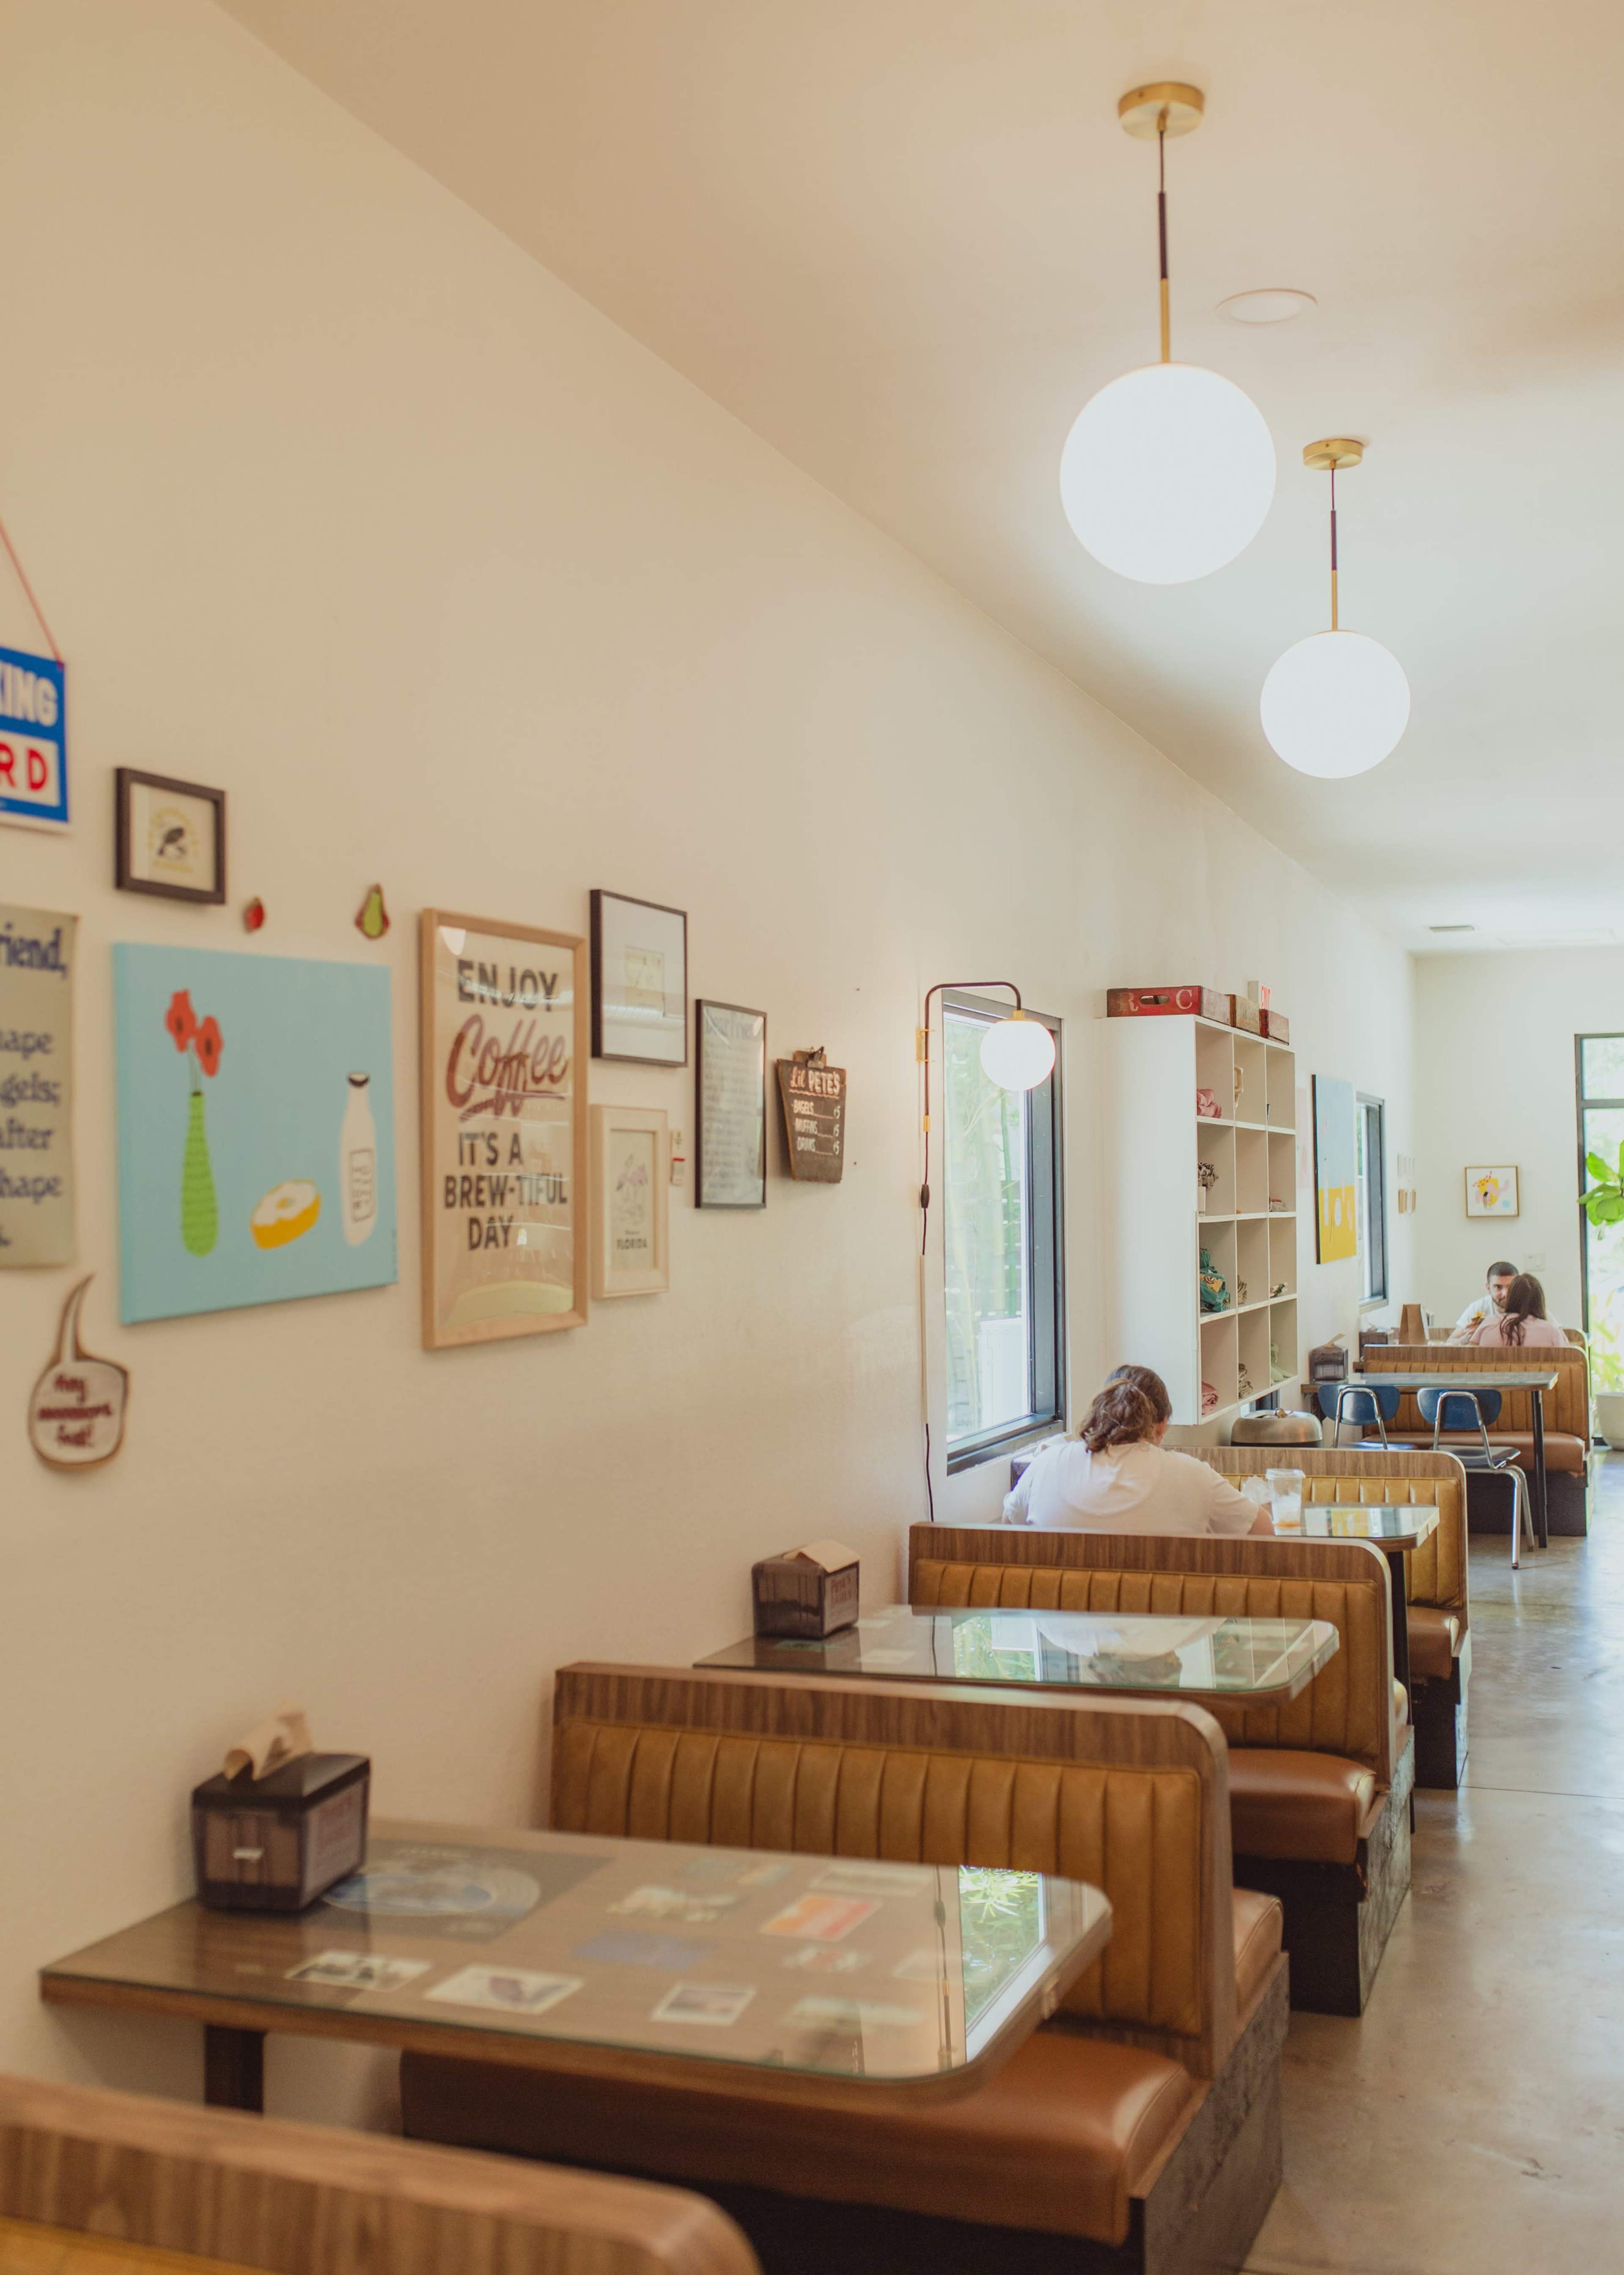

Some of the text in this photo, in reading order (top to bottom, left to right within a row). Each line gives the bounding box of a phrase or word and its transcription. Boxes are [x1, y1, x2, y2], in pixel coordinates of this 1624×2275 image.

[457, 959, 558, 1011] ENJOY
[1116, 989, 1192, 1011] R C
[446, 1014, 569, 1121] Coffee
[808, 1070, 840, 1095] PETE'S
[793, 1099, 814, 1115] BAGELS
[795, 1118, 818, 1135] MUFFINS
[458, 1131, 523, 1166] IT'S A
[444, 1173, 568, 1209] BREW-TIFUL
[468, 1215, 514, 1251] DAY
